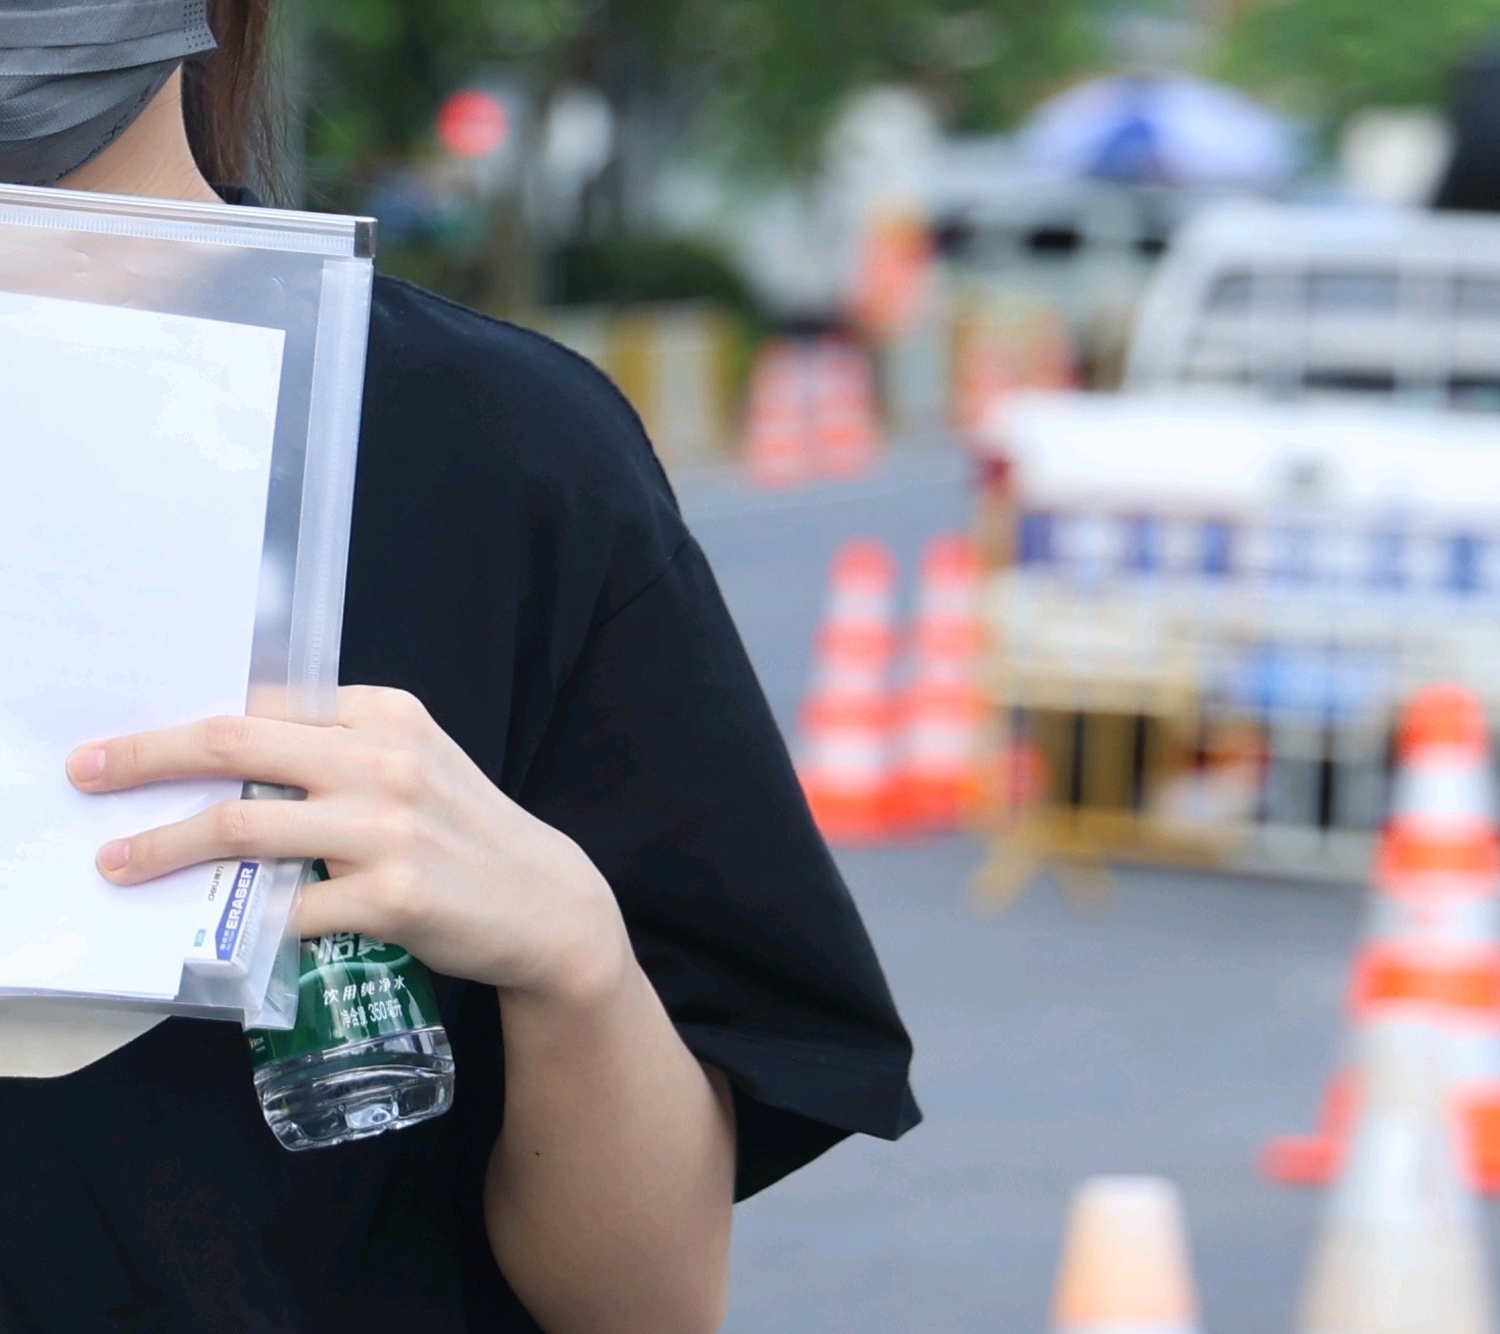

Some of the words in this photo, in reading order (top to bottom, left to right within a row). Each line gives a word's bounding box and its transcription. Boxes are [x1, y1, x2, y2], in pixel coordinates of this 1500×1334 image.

[226, 867, 254, 930] ERASER
[322, 974, 406, 1006] 饮用纯净水
